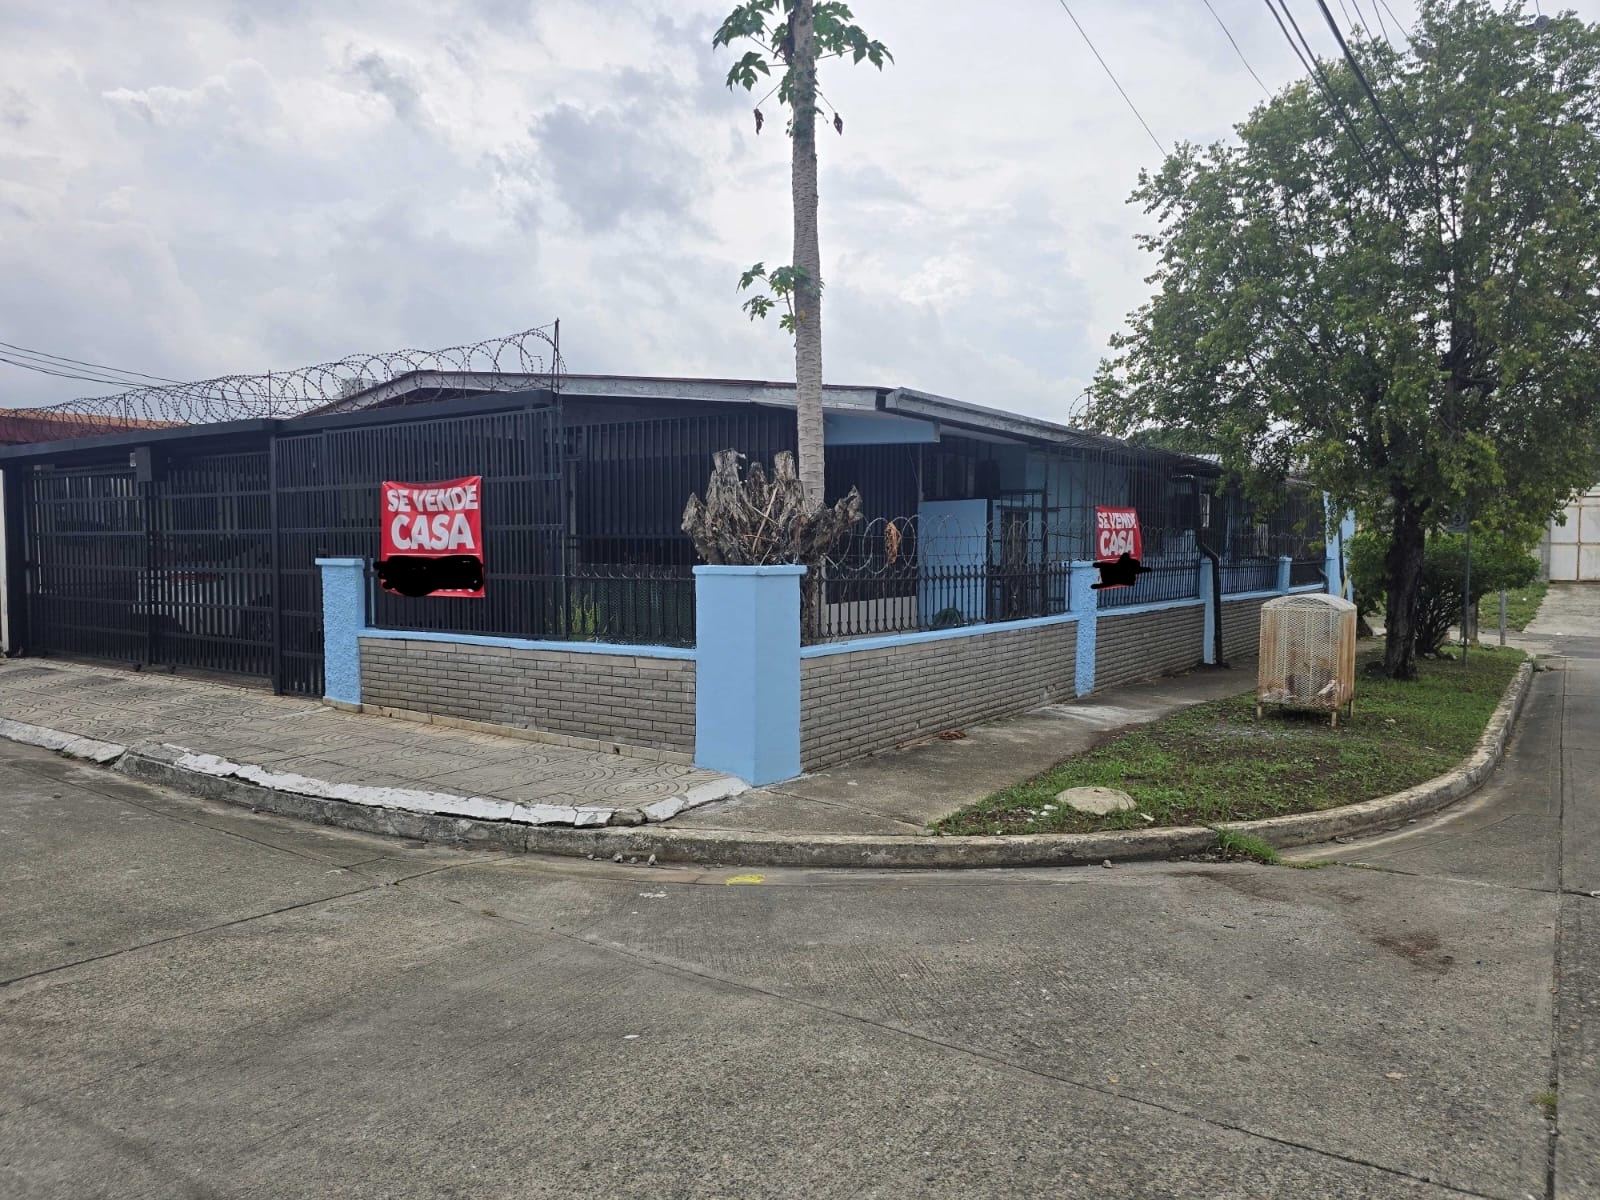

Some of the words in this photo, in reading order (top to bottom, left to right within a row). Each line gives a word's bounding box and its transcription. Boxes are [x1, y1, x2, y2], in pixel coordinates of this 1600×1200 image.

[387, 489, 411, 512] SE
[412, 485, 478, 512] VENDE
[391, 514, 475, 550] CASA
[1097, 512, 1112, 528] SE
[1101, 530, 1135, 556] CASA
